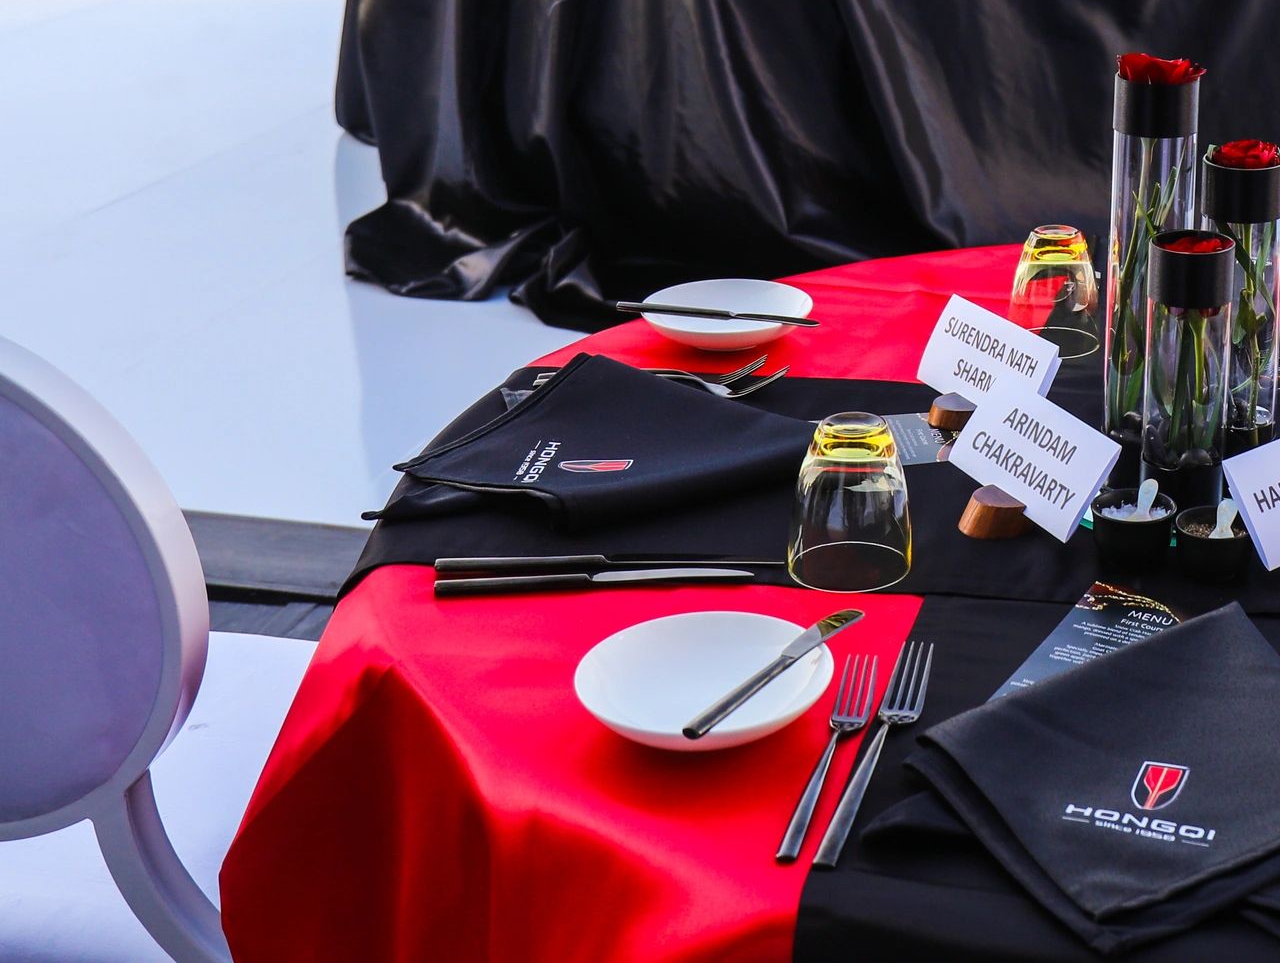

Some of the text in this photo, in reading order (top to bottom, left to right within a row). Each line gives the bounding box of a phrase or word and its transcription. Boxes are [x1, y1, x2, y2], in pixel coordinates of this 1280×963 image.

[944, 316, 1039, 378] SURENDRA NATH
[1002, 408, 1078, 465] ARINDAM
[521, 441, 561, 483] HONGQI
[972, 431, 1076, 510] CHAKRAVARTY
[1120, 618, 1139, 628] First
[1127, 610, 1173, 626] MENU
[1065, 803, 1216, 841] HONGQI
